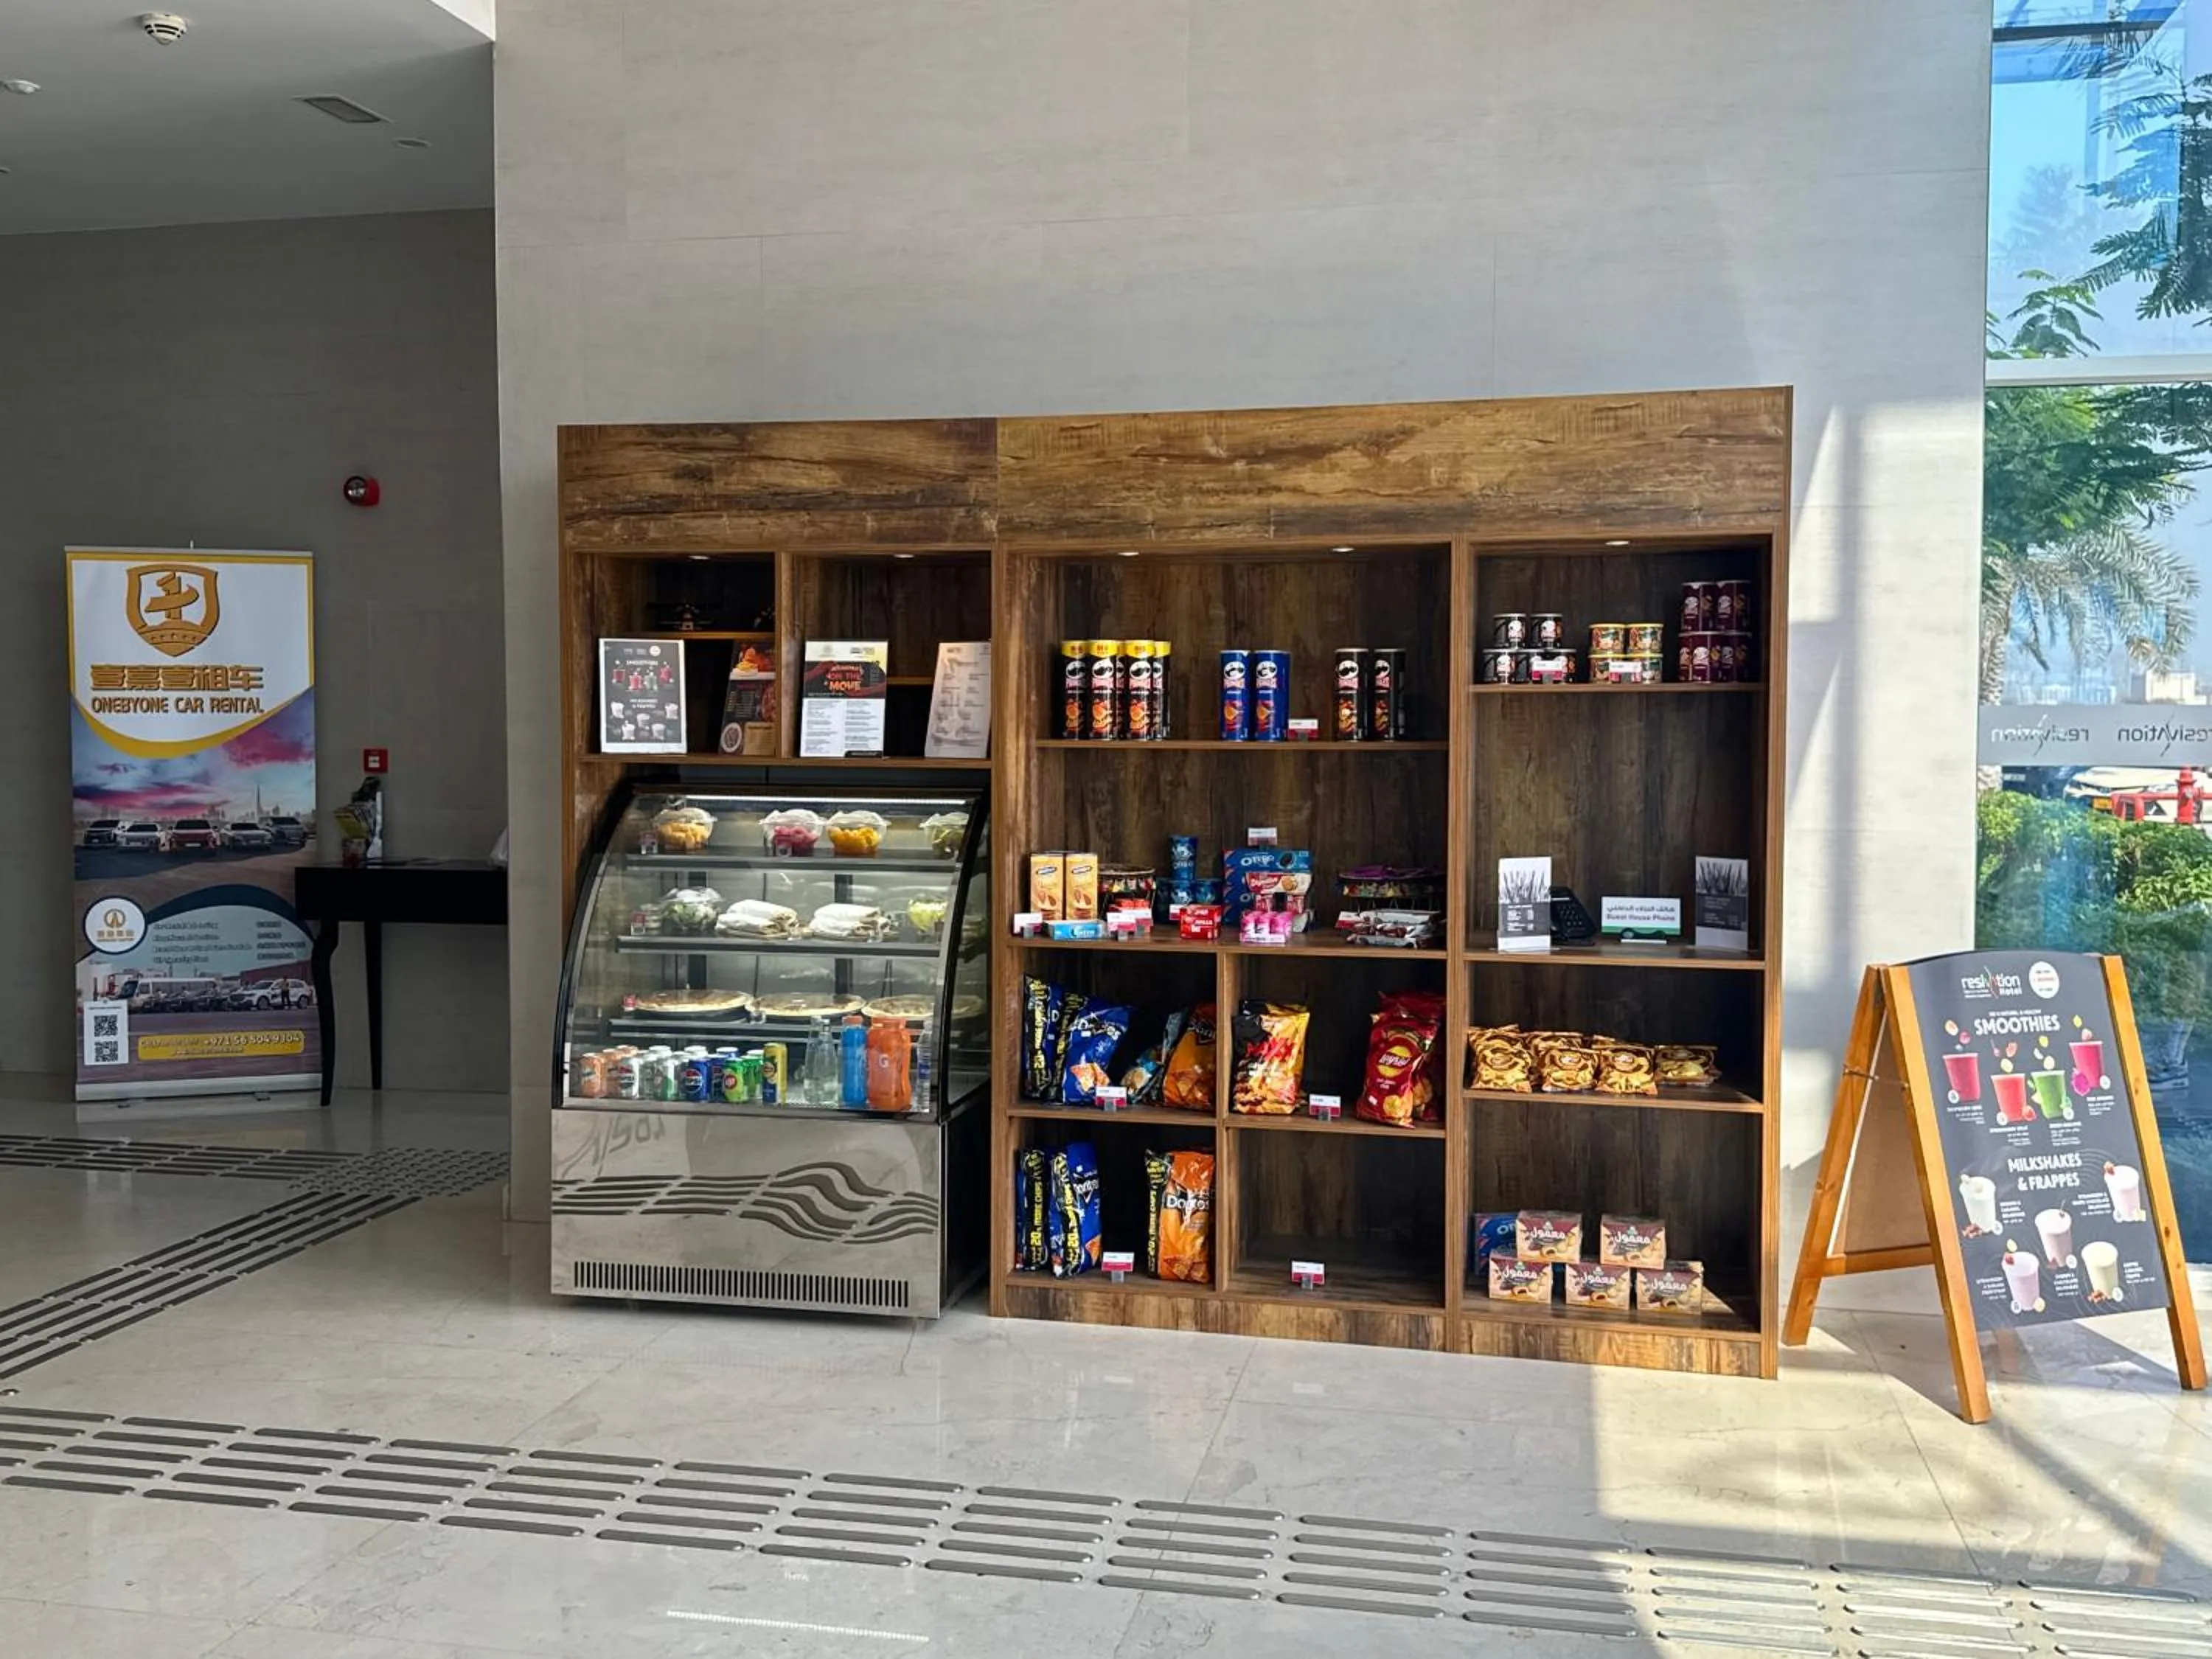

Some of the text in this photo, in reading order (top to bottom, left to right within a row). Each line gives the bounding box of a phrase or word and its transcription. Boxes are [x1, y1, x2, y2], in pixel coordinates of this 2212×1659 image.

[91, 697, 264, 714] ONEBYONE CAR RENTAL
[1974, 1014, 2061, 1035] SMOOTHIES
[2007, 1152, 2082, 1173] MILKSHAKES
[2017, 1172, 2080, 1191] & FRAPPES
